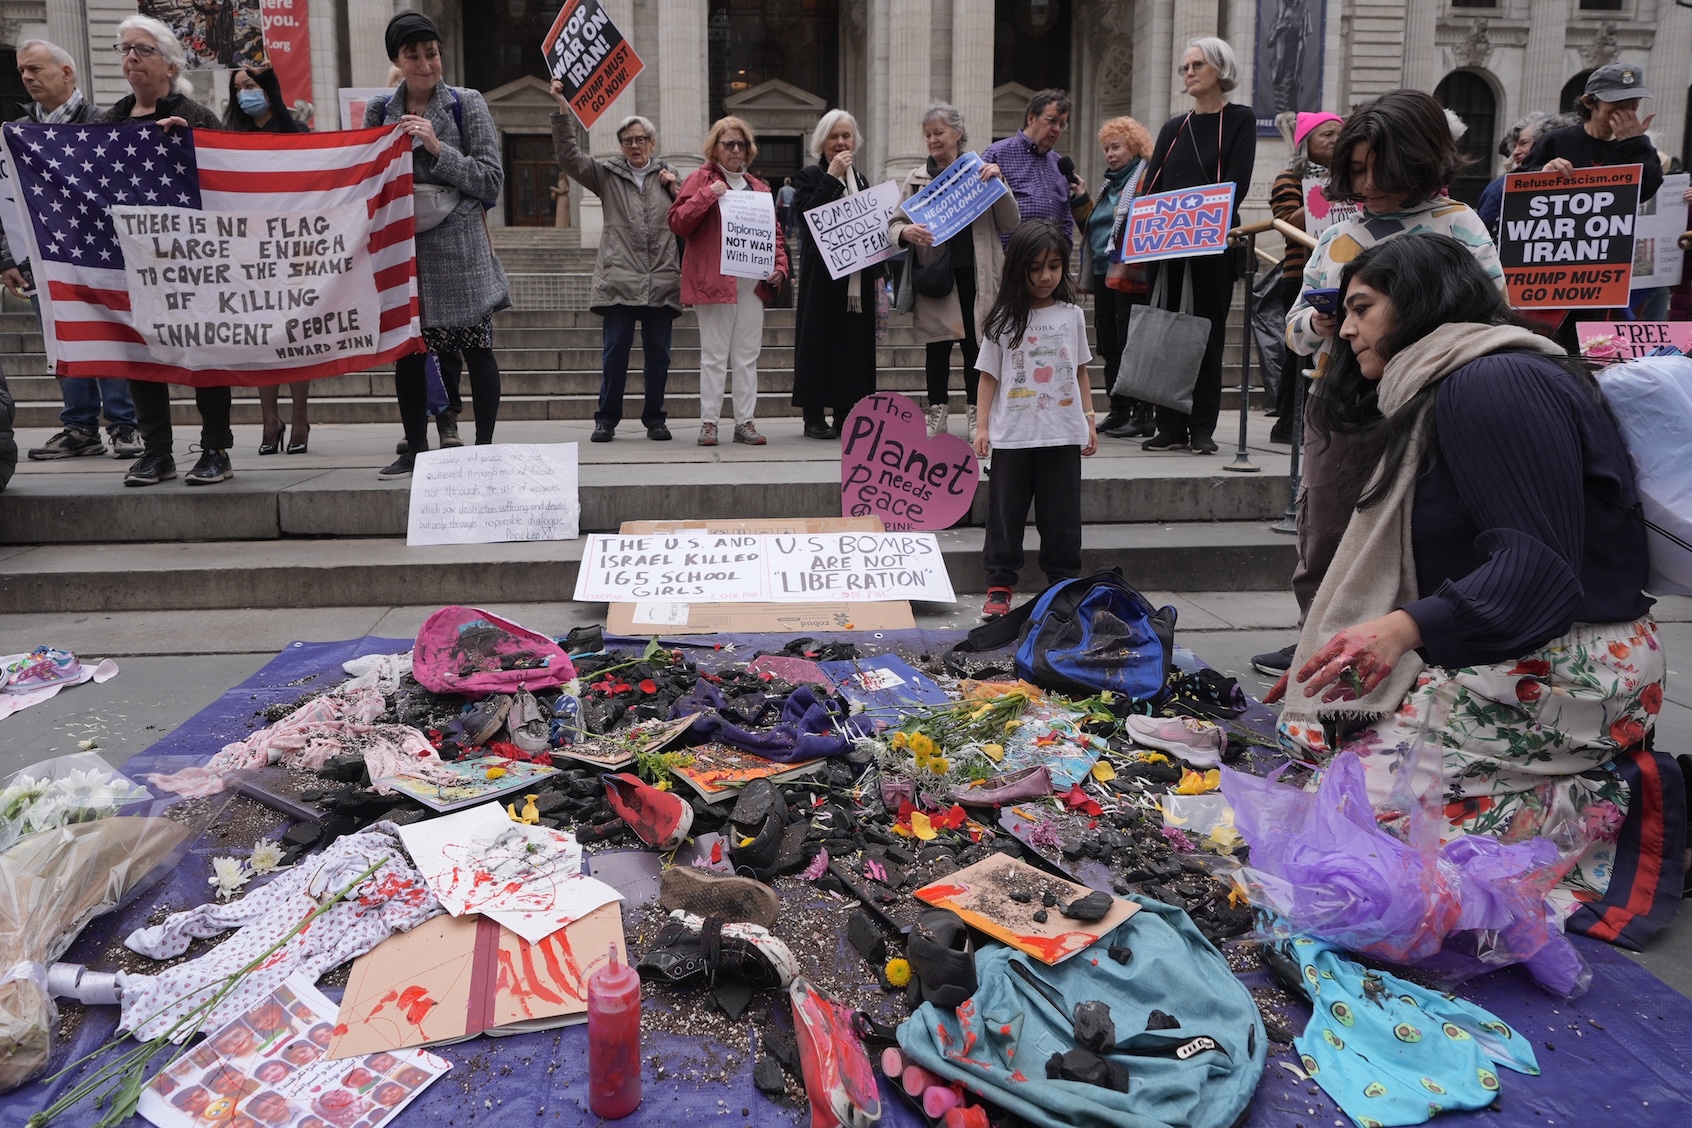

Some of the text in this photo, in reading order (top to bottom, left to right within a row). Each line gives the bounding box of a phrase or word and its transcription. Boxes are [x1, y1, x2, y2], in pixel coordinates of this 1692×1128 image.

[263, 15, 299, 30] you.
[555, 5, 586, 56] STOP
[553, 7, 608, 80] WAR ON
[567, 34, 611, 88] IRAN!
[575, 45, 629, 111] TRUMP MUST
[591, 67, 629, 113] GO NOW!
[1514, 173, 1633, 189] RefuseFascism.org
[810, 192, 878, 232] BOMBING
[928, 221, 938, 231] &
[938, 180, 988, 224] DIPLOMACY
[1154, 192, 1205, 216] NO
[1528, 192, 1615, 217] STOP
[121, 214, 330, 238] THERE IS NO FLAG
[727, 222, 772, 241] Diplomacy
[820, 213, 882, 250] SCHOOLS
[1134, 208, 1223, 236] IRAN
[1506, 214, 1634, 242] WAR ON
[152, 234, 345, 261] LARGE ENOUGH
[726, 236, 773, 252] NOT WAR
[830, 229, 890, 268] NOT FEM
[1132, 227, 1221, 253] WAR
[1522, 239, 1610, 263] IRAN!
[726, 249, 773, 266] With Iran!
[137, 256, 354, 286] TO COVER THE SHAME
[1505, 269, 1625, 286] TRUMP MUST
[166, 288, 320, 314] OF KILLING
[1521, 287, 1602, 301] GO NOW!
[154, 308, 359, 347] INNOCENT PEOPLE
[1029, 324, 1054, 332] YORK
[1614, 324, 1672, 344] FREE
[275, 334, 373, 359] HOWARD ZINN
[868, 396, 913, 423] The
[844, 416, 973, 495] Planet
[426, 465, 463, 480] achieved
[467, 466, 498, 480] through
[424, 489, 440, 498] nor
[444, 483, 480, 499] through
[486, 482, 498, 494] the
[500, 485, 515, 494] use
[878, 470, 933, 501] needs
[418, 503, 440, 515] which
[498, 500, 528, 514] suffering
[530, 500, 544, 511] and
[418, 518, 430, 530] but
[485, 514, 523, 529] responsible
[527, 513, 565, 528] dialogue
[506, 528, 525, 540] Pope
[526, 527, 540, 540] Leo
[598, 538, 653, 552] THE
[714, 537, 757, 548] AND
[839, 536, 933, 555] BOMBS
[600, 553, 759, 568] ISRAEL KILLED
[811, 554, 910, 570] ARE NOT
[604, 571, 742, 586] 165 SCHOOL
[632, 586, 704, 597] GIRLS
